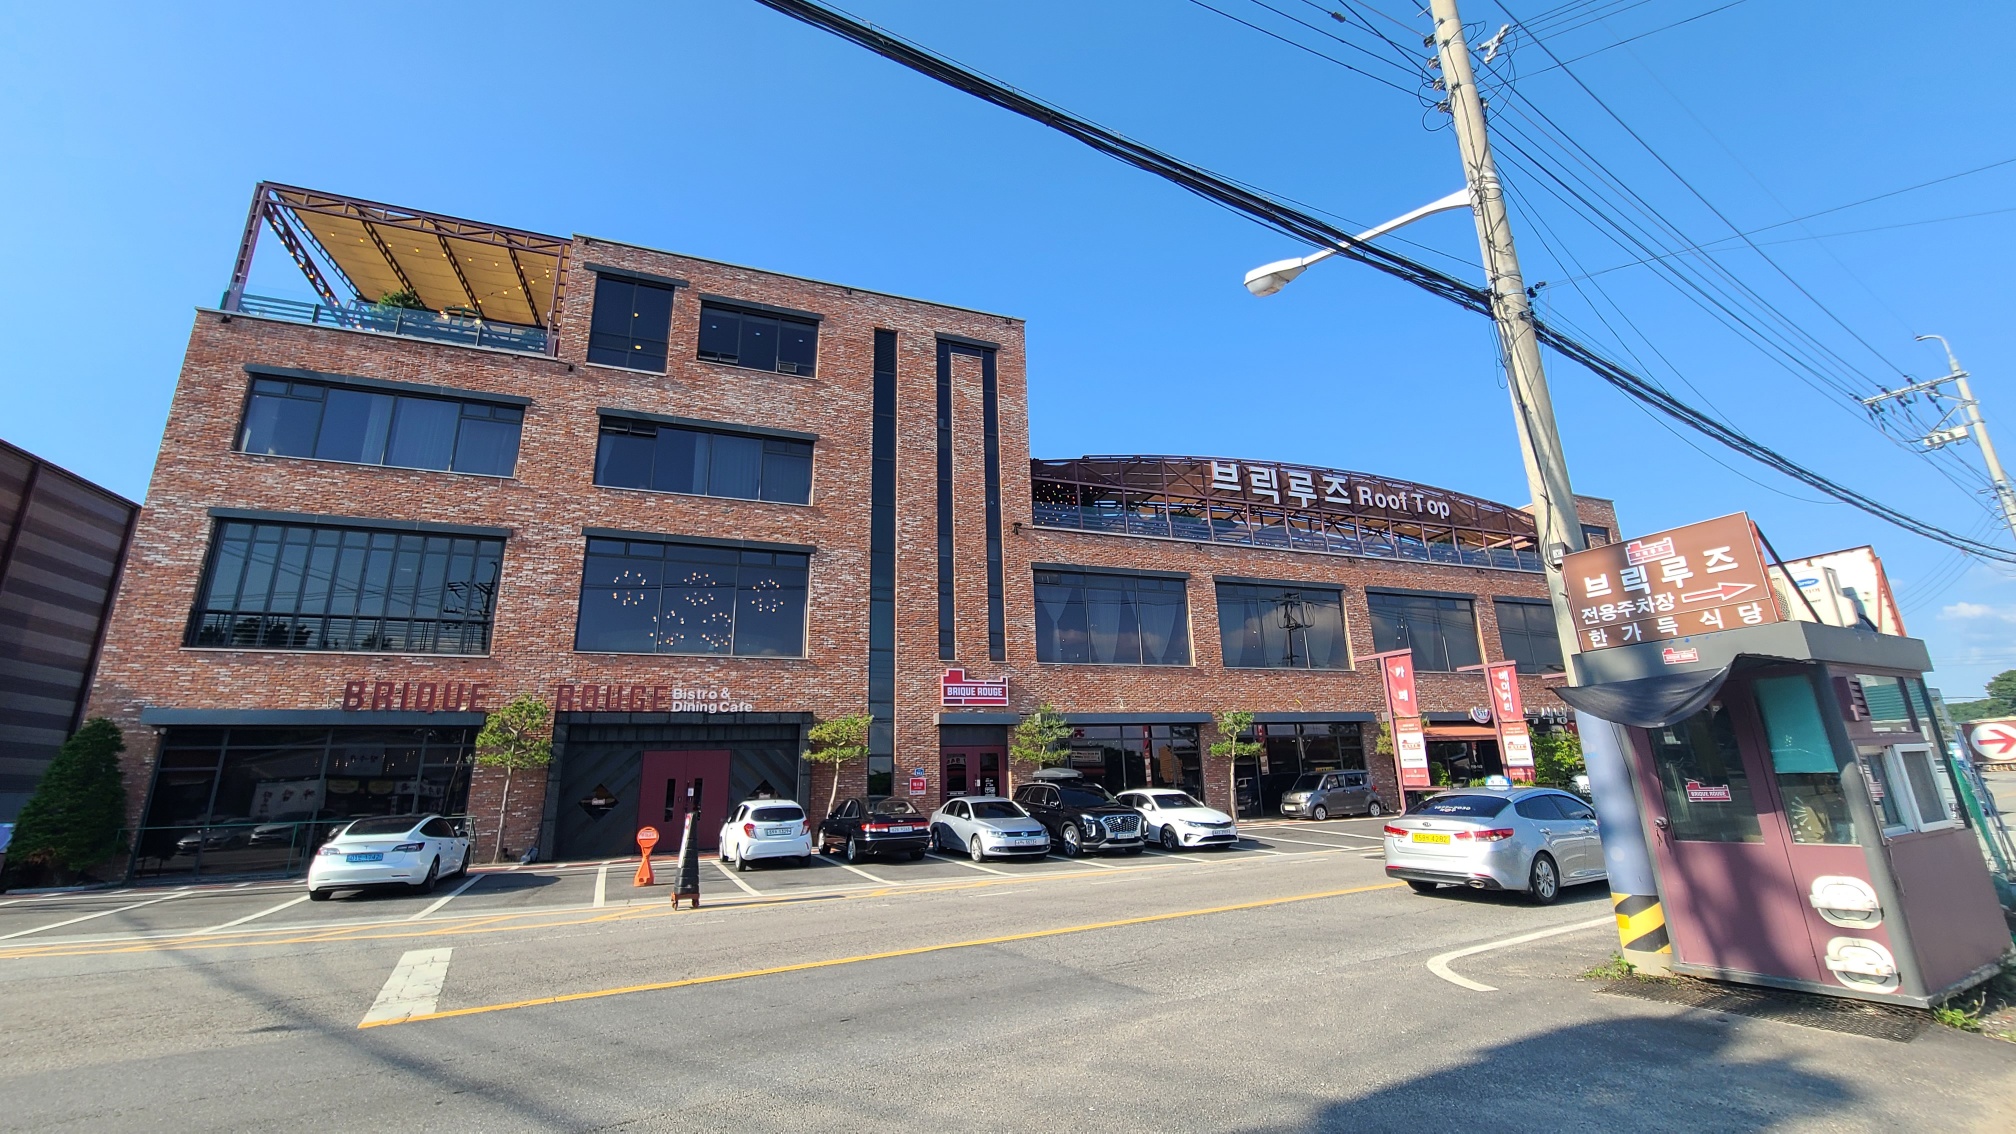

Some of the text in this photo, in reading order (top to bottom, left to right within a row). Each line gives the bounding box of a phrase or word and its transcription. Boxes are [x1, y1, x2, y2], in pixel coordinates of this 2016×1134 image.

[1211, 461, 1450, 520] 브릭루즈 Roof Top
[1584, 545, 1739, 598] 브릭루즈
[1581, 592, 1675, 625] 전용주차장
[342, 681, 670, 713] BRIQUE ROUGE
[672, 687, 730, 700] Bistro &
[947, 686, 1003, 697] BRIQUE ROUGE
[1395, 666, 1408, 701] 카페
[1498, 670, 1513, 713] 베이커리
[671, 701, 753, 714] Dining Cafe
